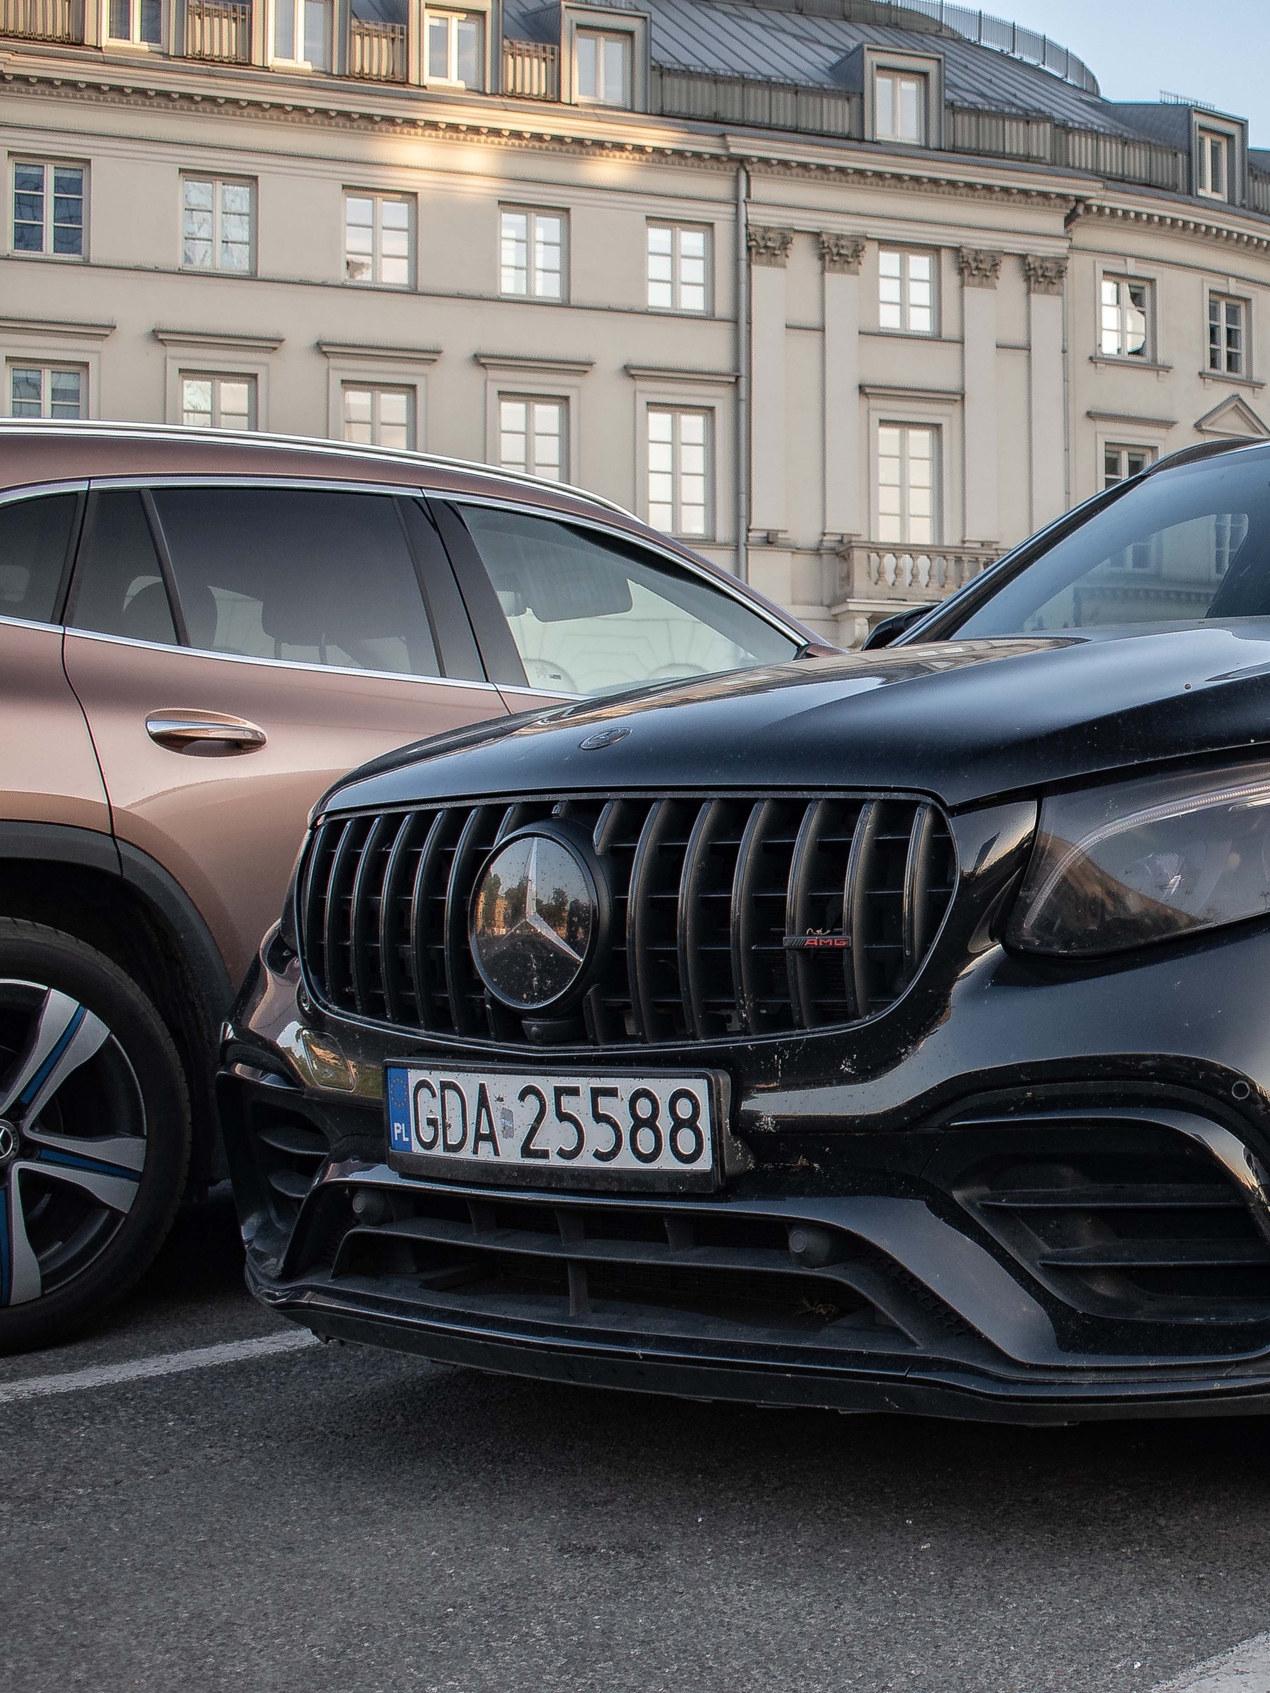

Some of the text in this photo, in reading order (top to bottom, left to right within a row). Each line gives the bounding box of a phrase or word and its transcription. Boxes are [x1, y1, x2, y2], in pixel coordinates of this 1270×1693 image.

[804, 938, 847, 947] AMG
[413, 1078, 705, 1164] GDA 25588
[394, 1122, 410, 1142] PL
